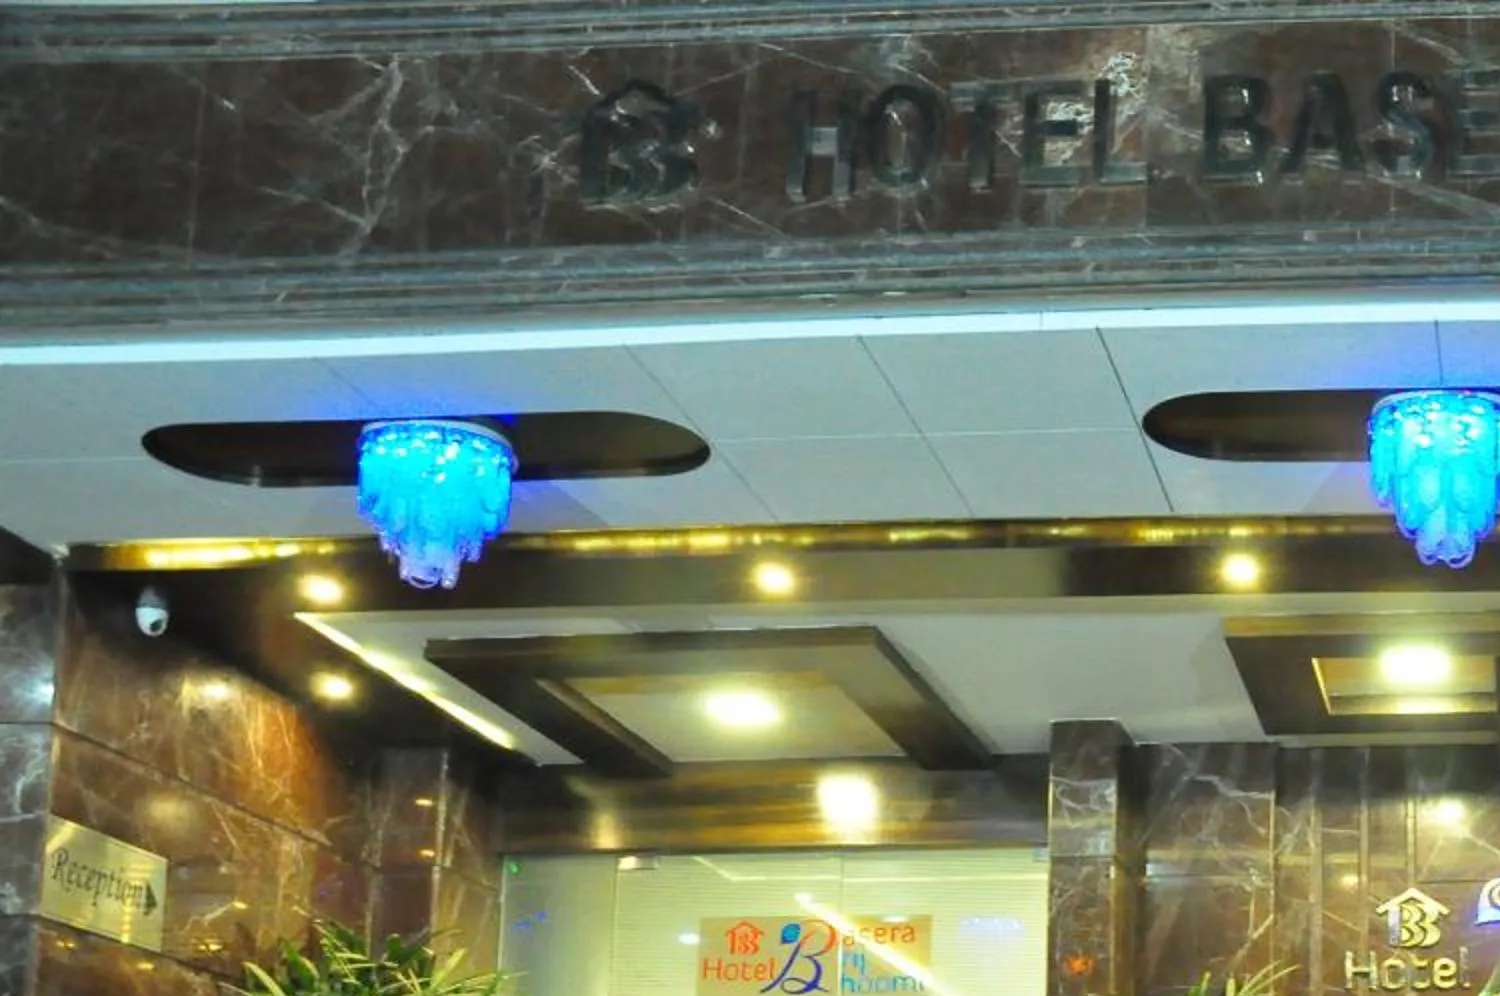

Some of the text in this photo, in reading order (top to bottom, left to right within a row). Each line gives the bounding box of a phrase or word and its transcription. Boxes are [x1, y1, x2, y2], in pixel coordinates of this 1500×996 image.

[786, 78, 1148, 202] HOTEL
[51, 848, 143, 908] Reception
[702, 957, 776, 981] Hotel
[1344, 946, 1471, 990] Hotel
